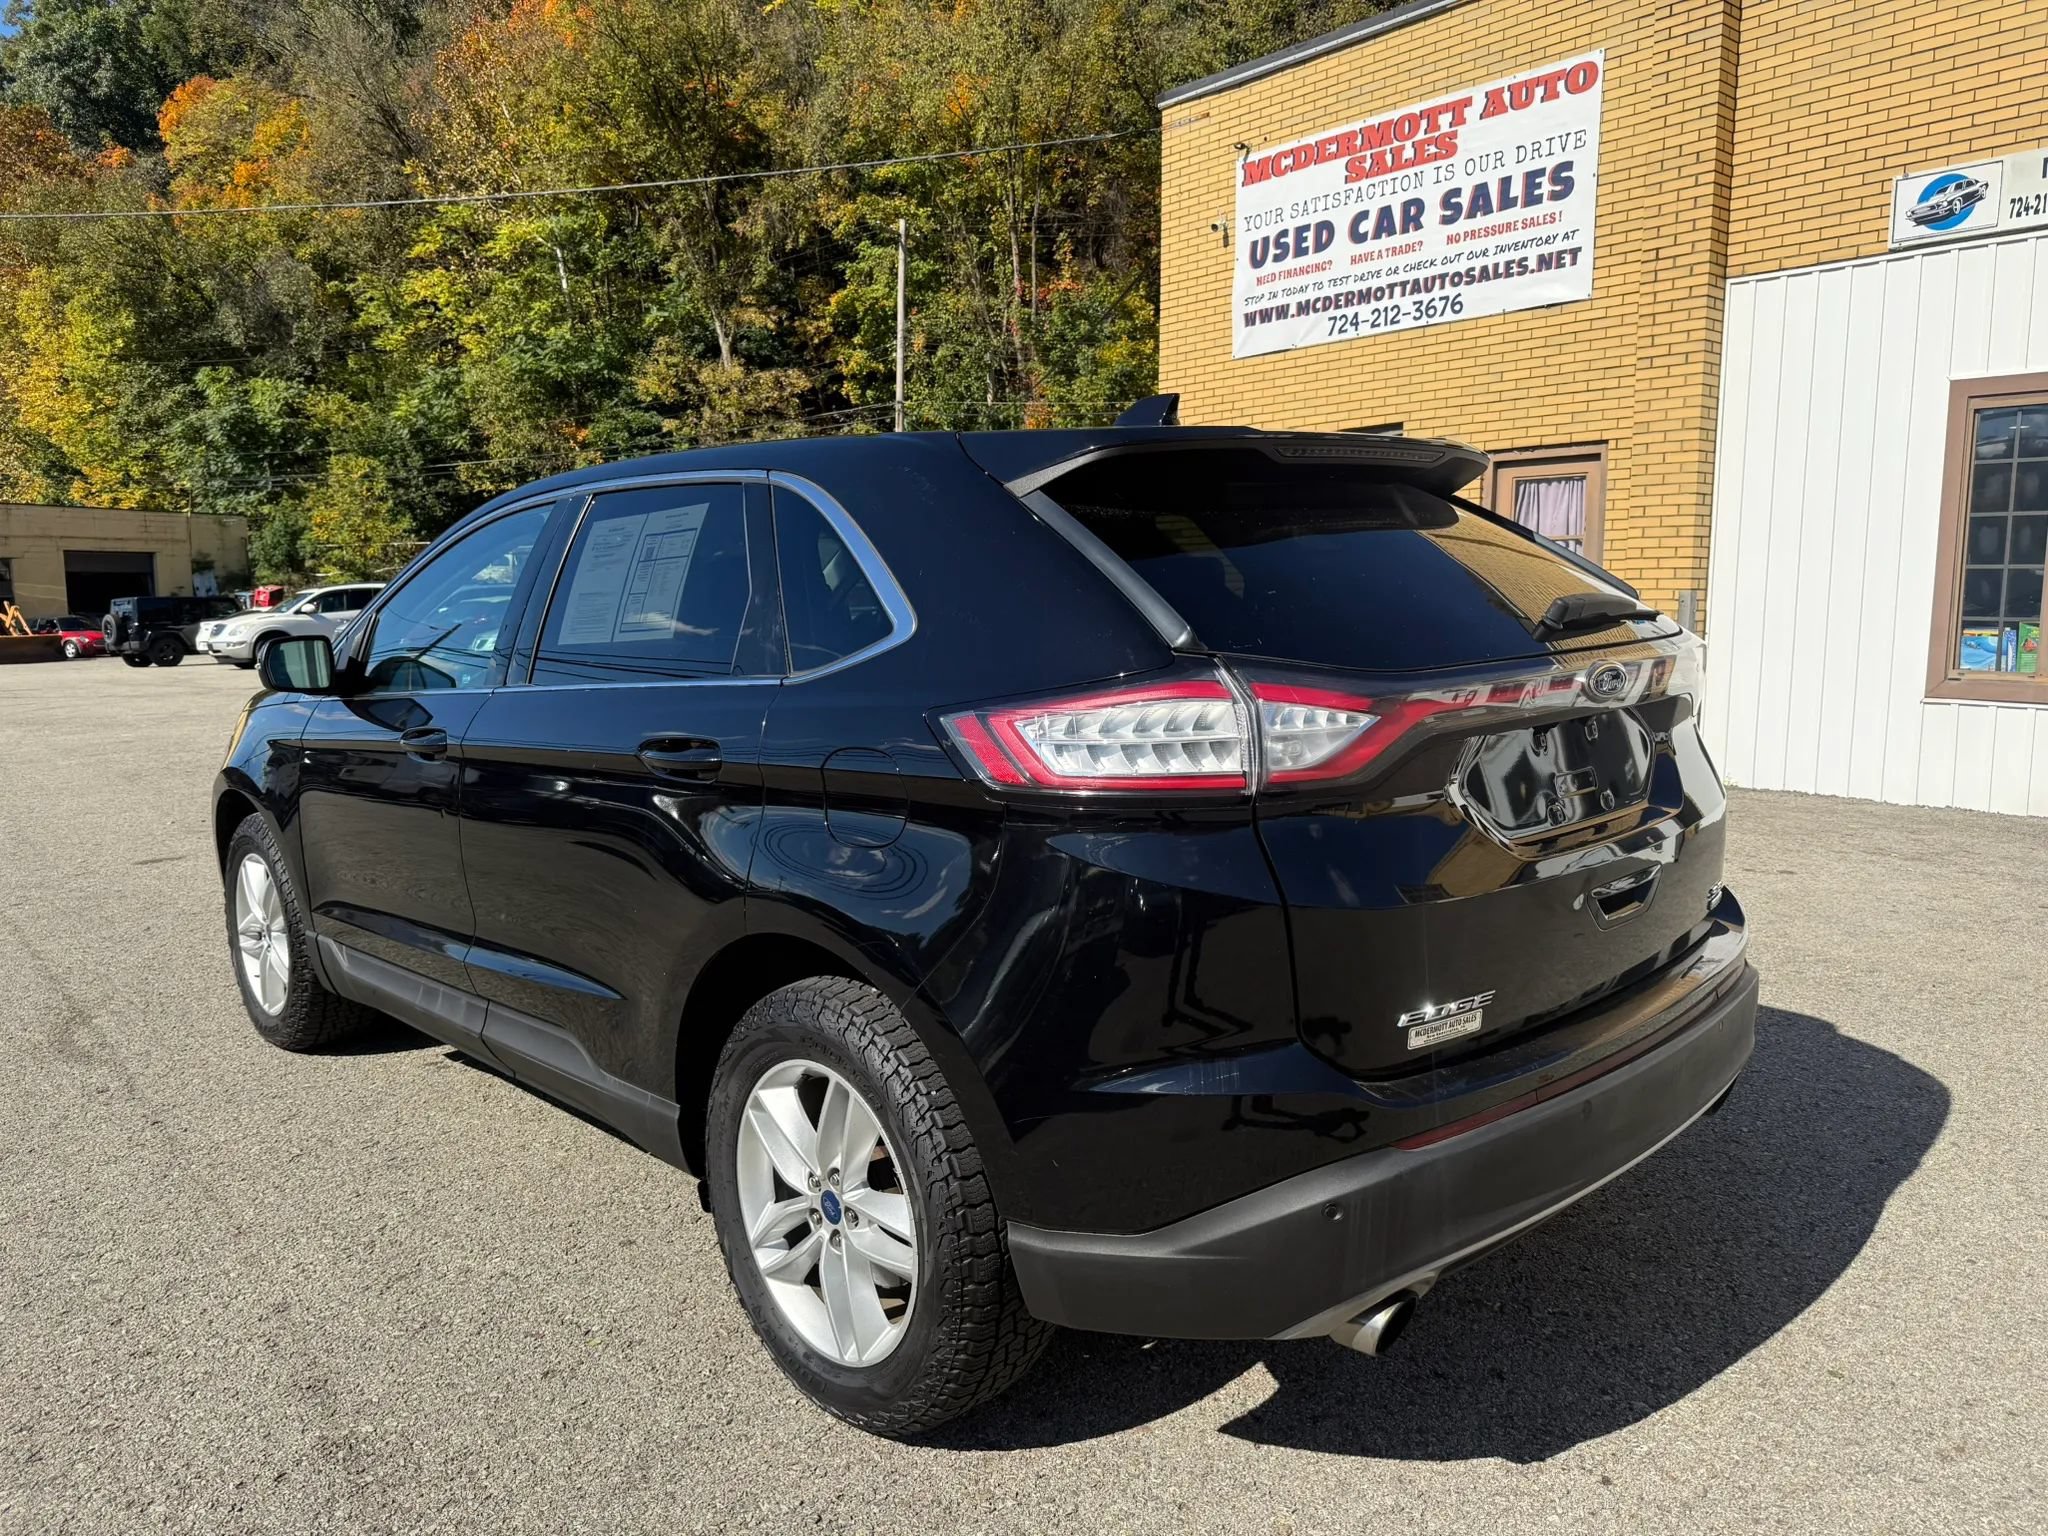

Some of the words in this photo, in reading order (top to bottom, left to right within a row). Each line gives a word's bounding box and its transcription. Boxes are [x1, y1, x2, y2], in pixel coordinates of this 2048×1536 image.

[1242, 96, 1472, 187] MCDERMOTT
[1479, 61, 1599, 120] AUTO
[1244, 207, 1284, 232] YOUR
[1290, 171, 1424, 220] SATISFACTION
[1433, 164, 1455, 185] IS
[1465, 151, 1505, 176] OUR
[1516, 129, 1587, 164] DRIVE
[1345, 129, 1458, 184] SALES
[1249, 220, 1335, 270] USED
[1348, 197, 1425, 245] CAR
[1439, 160, 1575, 226] SALES
[1446, 232, 1461, 245] NO
[1463, 219, 1519, 242] PRESSURE
[1244, 293, 1265, 306] STOP
[1267, 290, 1278, 300] IN
[1281, 283, 1310, 297] TODAY
[1312, 281, 1325, 292] TO
[1327, 274, 1352, 288] TEST
[1354, 268, 1382, 283] DRIVE
[1386, 265, 1400, 277] OR
[1403, 257, 1438, 273] CHECK
[1441, 252, 1465, 266] OUT
[1466, 247, 1490, 261] OUR
[1493, 232, 1559, 256] INVENTORY
[1561, 228, 1580, 242] AT
[1256, 271, 1277, 286] NEED
[1278, 259, 1333, 281] FINANCING?
[1350, 250, 1376, 265] HAVE
[1377, 249, 1383, 260] A
[1386, 240, 1424, 257] TRADE?
[1243, 246, 1582, 328] WWW.MCDERMOTTAUTOSALES.NET
[1327, 292, 1464, 337] 724-212-3676
[1397, 990, 1496, 1027] EDGE
[1415, 1022, 1449, 1038] MCDERMOTT
[1448, 1019, 1462, 1029] AUTO
[1463, 1014, 1477, 1025] SALES
